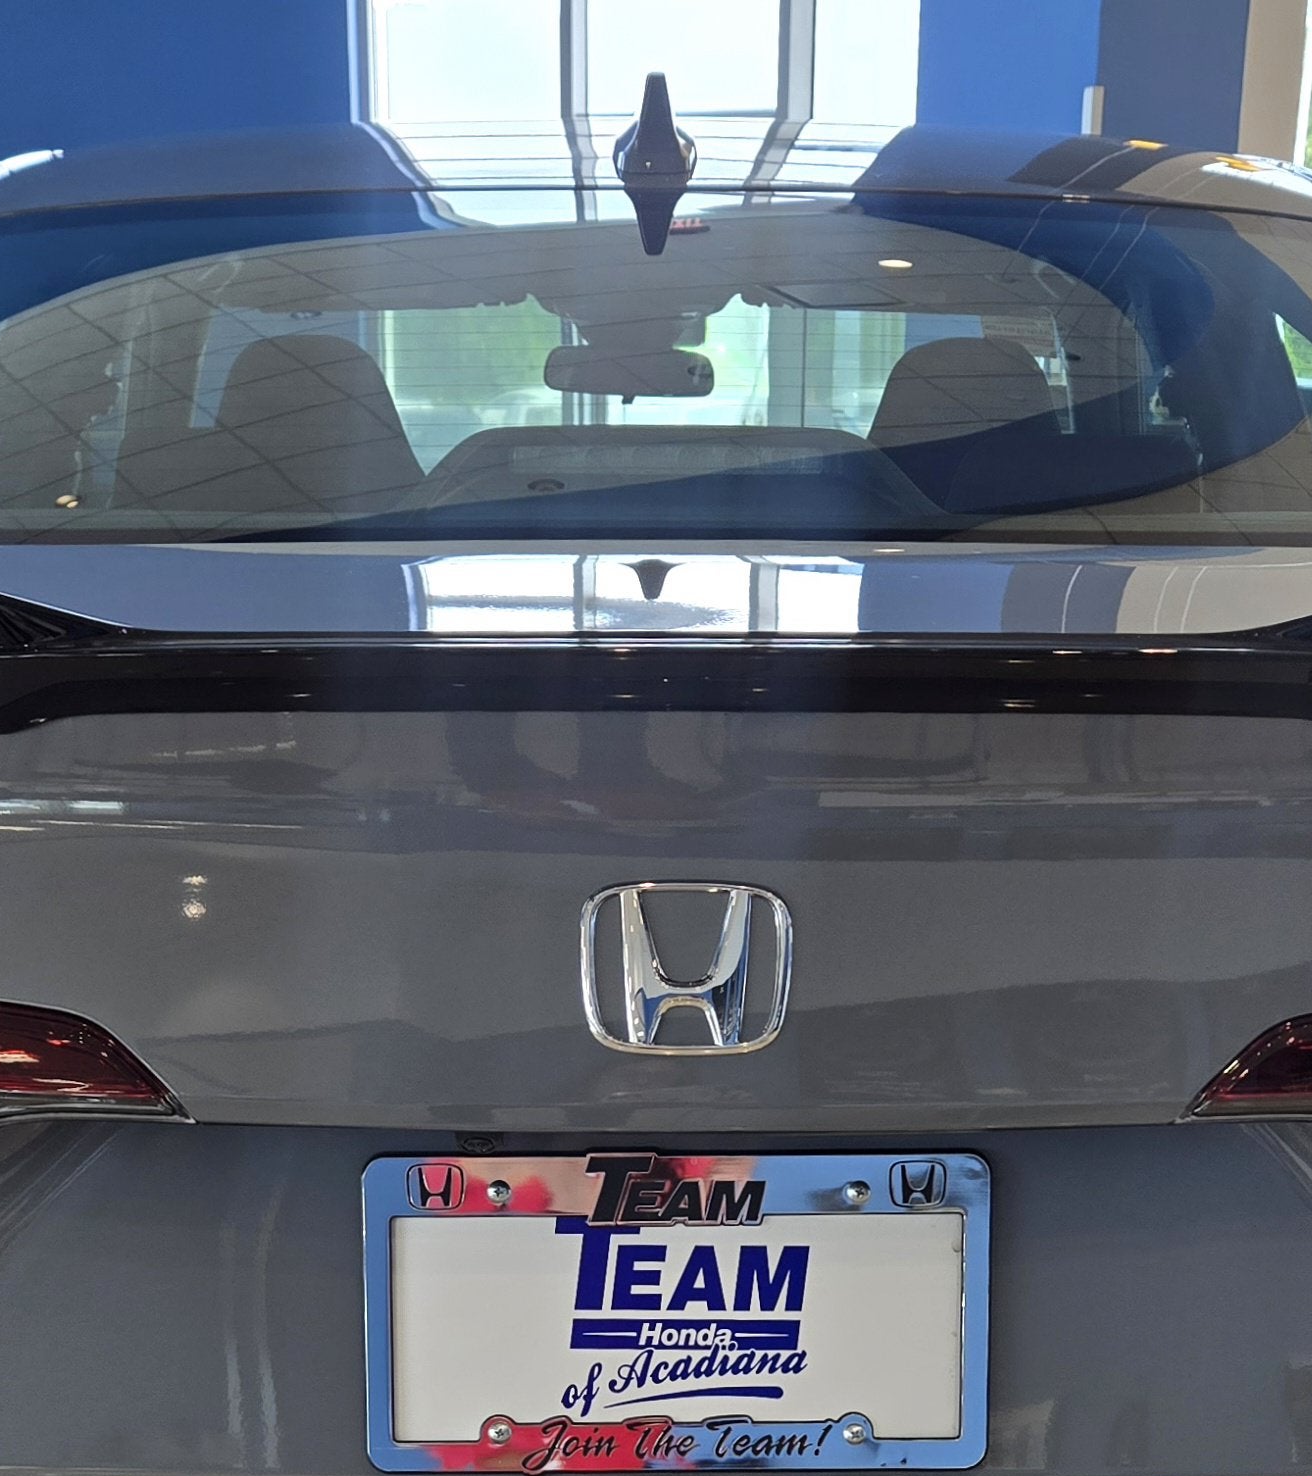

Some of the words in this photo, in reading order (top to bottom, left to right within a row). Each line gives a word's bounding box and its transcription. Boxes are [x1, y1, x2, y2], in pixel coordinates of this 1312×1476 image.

[585, 1155, 767, 1222] TEAM
[555, 1215, 810, 1312] TEAM
[638, 1322, 733, 1347] Honda
[560, 1362, 603, 1417] of
[608, 1341, 809, 1394] Acadiana
[522, 1418, 620, 1470] Join
[626, 1419, 700, 1459] The
[705, 1419, 834, 1459] Team!
